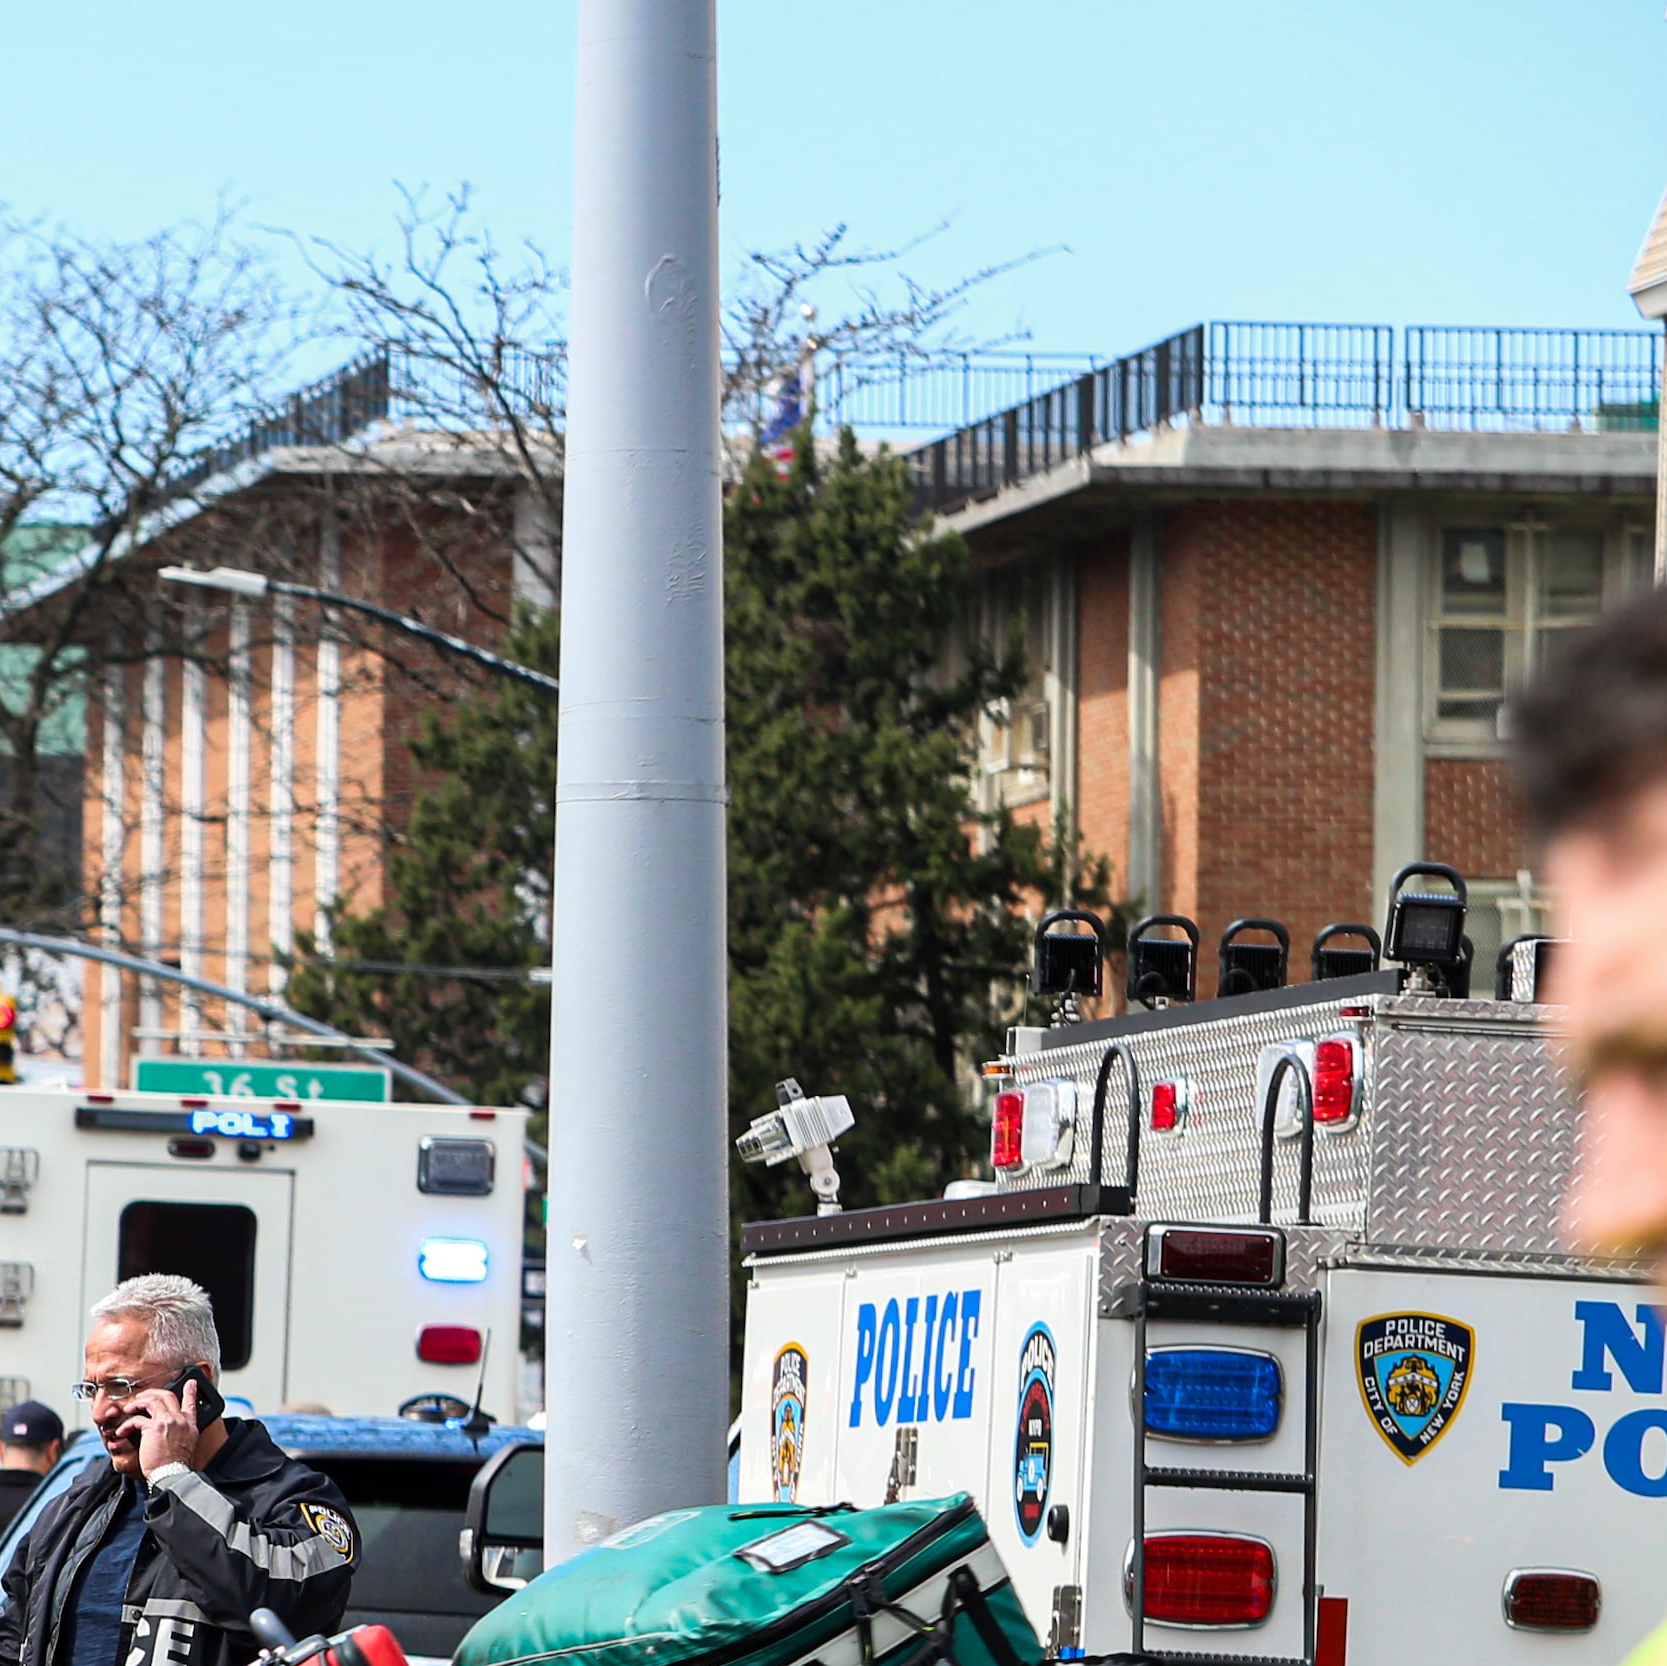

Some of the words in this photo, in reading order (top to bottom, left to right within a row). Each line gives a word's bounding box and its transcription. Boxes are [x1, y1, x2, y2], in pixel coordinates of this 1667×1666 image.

[275, 1075, 324, 1100] St
[190, 1110, 292, 1139] POLI
[1363, 1335, 1466, 1363] DEPARTMENT
[1385, 1318, 1447, 1339] POLICE
[849, 1289, 982, 1428] POLICE
[1364, 1376, 1385, 1412] CITY
[1380, 1416, 1399, 1436] OF
[1419, 1413, 1445, 1445] NEW
[1442, 1371, 1465, 1410] YORK
[1499, 1402, 1667, 1499] PO
